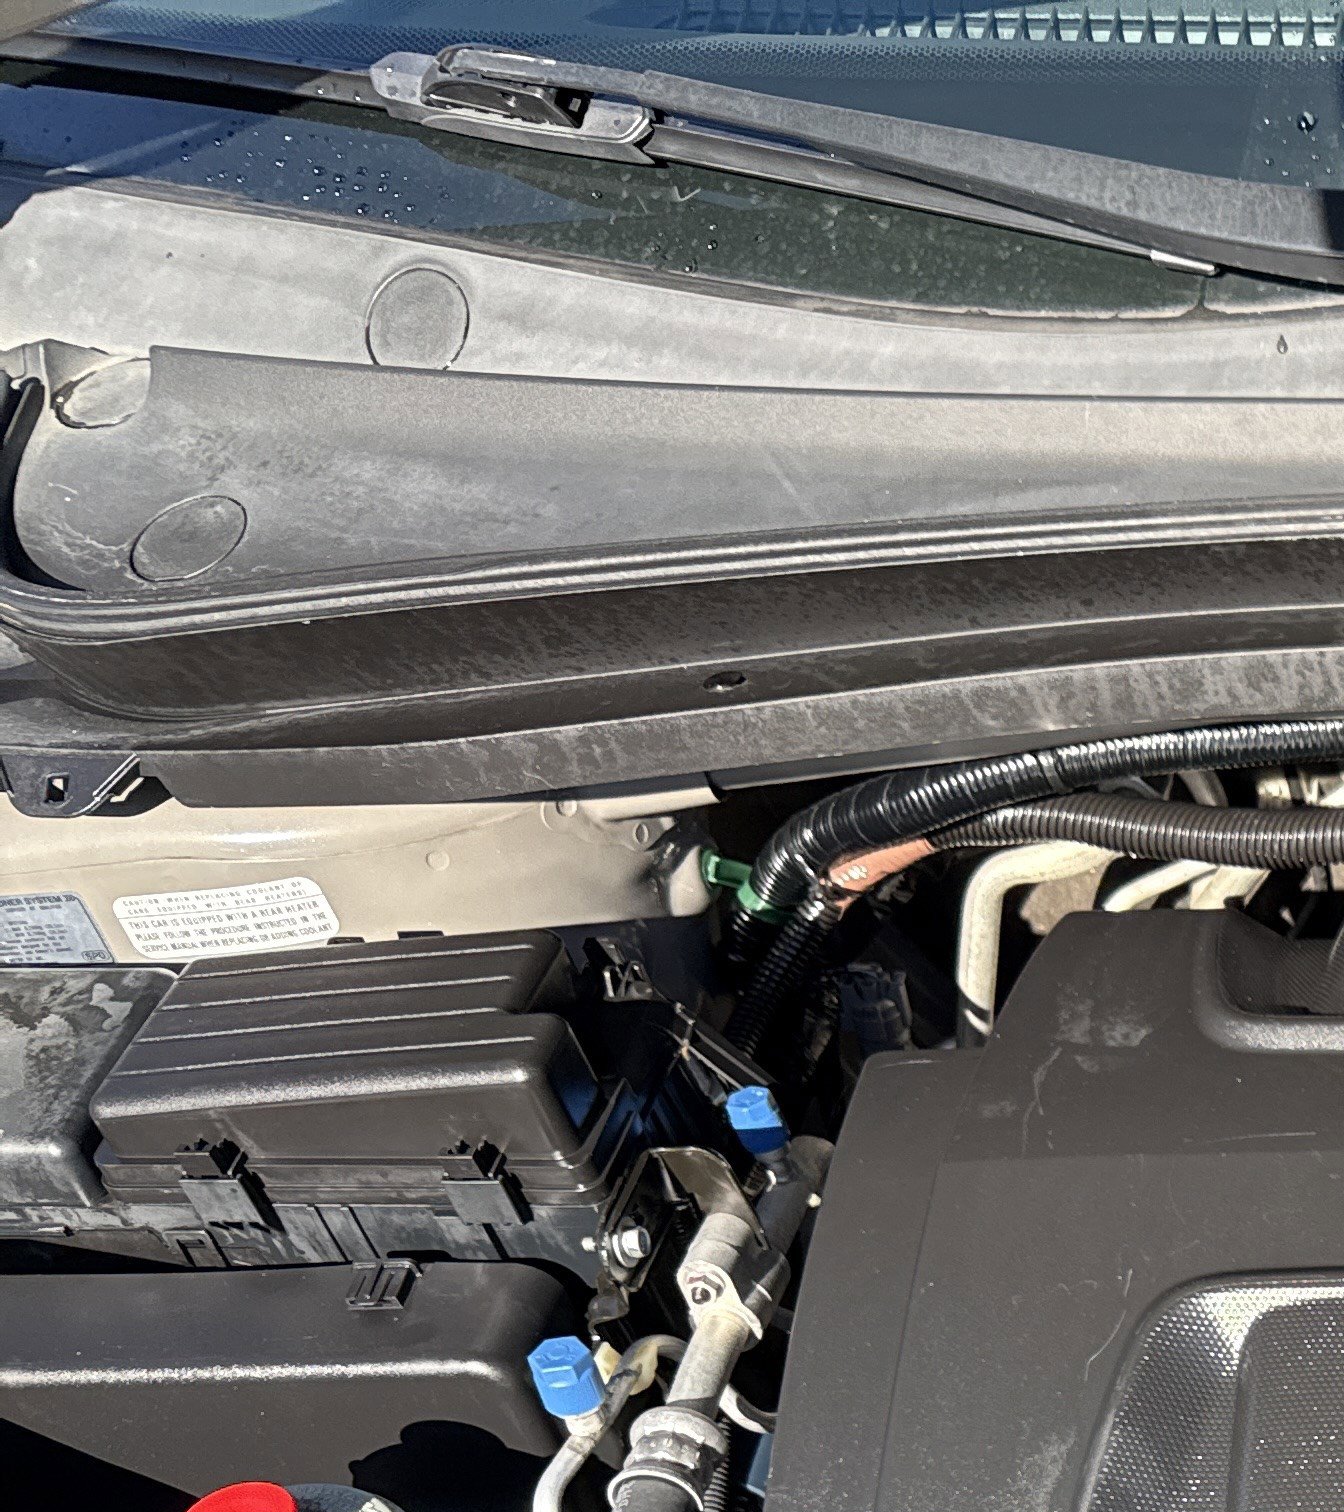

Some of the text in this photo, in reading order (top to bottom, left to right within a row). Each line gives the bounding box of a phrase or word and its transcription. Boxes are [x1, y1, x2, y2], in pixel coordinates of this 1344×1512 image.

[247, 885, 285, 895] COOLANT
[129, 921, 149, 930] THIS
[152, 919, 168, 928] CAR
[170, 918, 180, 927] IS
[181, 914, 223, 926] EQUIPPED
[226, 911, 248, 922] WITH
[261, 906, 282, 917] REAR
